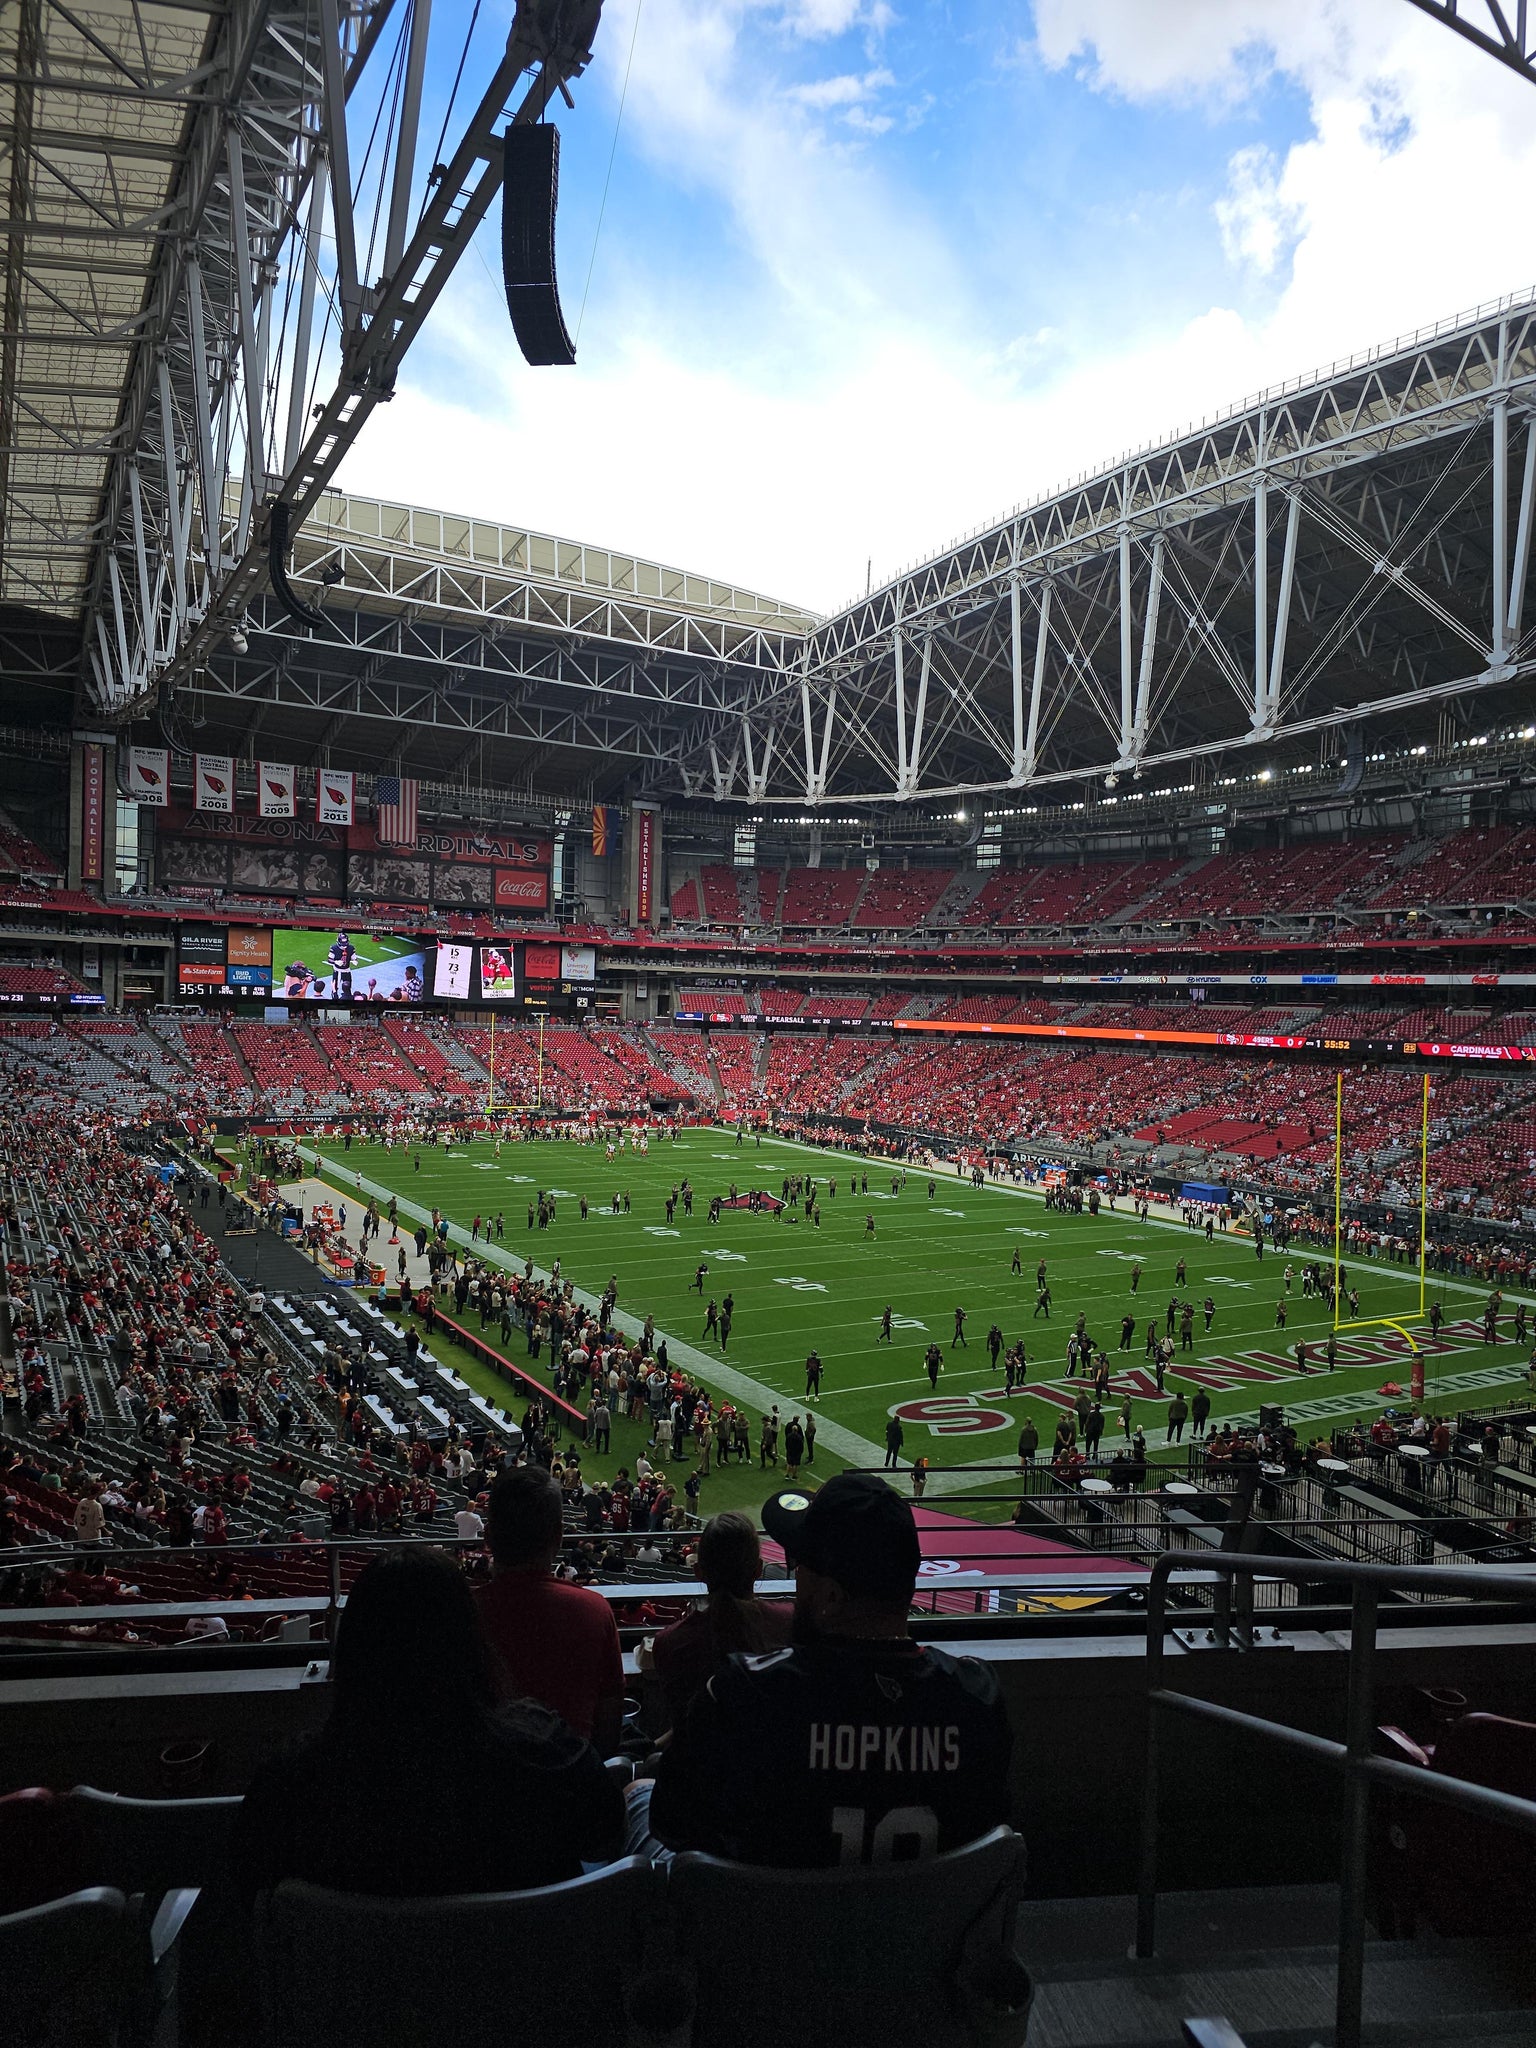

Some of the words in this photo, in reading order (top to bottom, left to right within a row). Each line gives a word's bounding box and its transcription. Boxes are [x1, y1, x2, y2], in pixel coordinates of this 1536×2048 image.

[89, 757, 98, 836] FOOTBALL
[134, 794, 163, 803] 008
[200, 800, 228, 810] 2008
[264, 807, 290, 815] 2009
[323, 812, 348, 821] 2015
[184, 810, 340, 843] ARIZONA
[88, 838, 97, 876] CLUB
[498, 878, 545, 898] Coca-Cola
[182, 936, 200, 944] GILA
[448, 963, 459, 972] 73
[1250, 976, 1268, 984] COX
[529, 984, 554, 992] verizon
[766, 1016, 806, 1024] R.PEARSALL
[1252, 1036, 1274, 1044] 49ERS
[1324, 1040, 1350, 1050] 35:52
[1432, 1045, 1440, 1054] 0
[1450, 1045, 1502, 1056] CARDINALS
[420, 1500, 430, 1510] 21
[612, 1503, 622, 1514] 85
[80, 1514, 86, 1526] 3
[809, 1722, 960, 1771] HOPKINS
